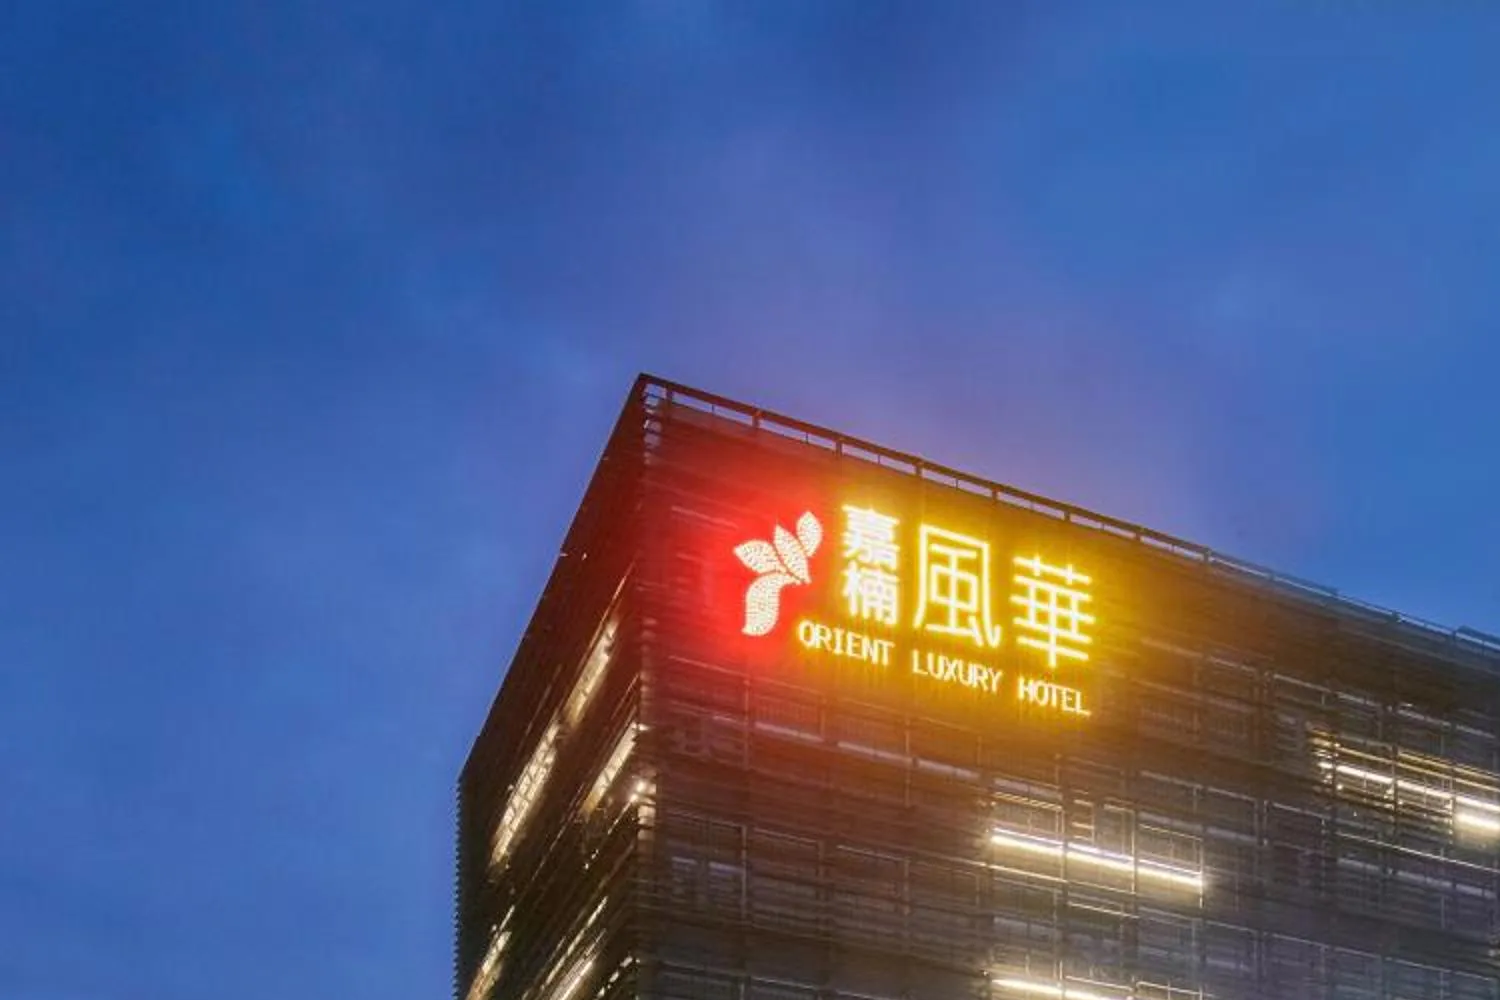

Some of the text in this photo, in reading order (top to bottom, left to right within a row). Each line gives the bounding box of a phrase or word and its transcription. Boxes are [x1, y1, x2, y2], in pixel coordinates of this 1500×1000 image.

[914, 524, 1095, 667] 風華
[797, 620, 1091, 716] ORIENT LUXURY HOTEL
